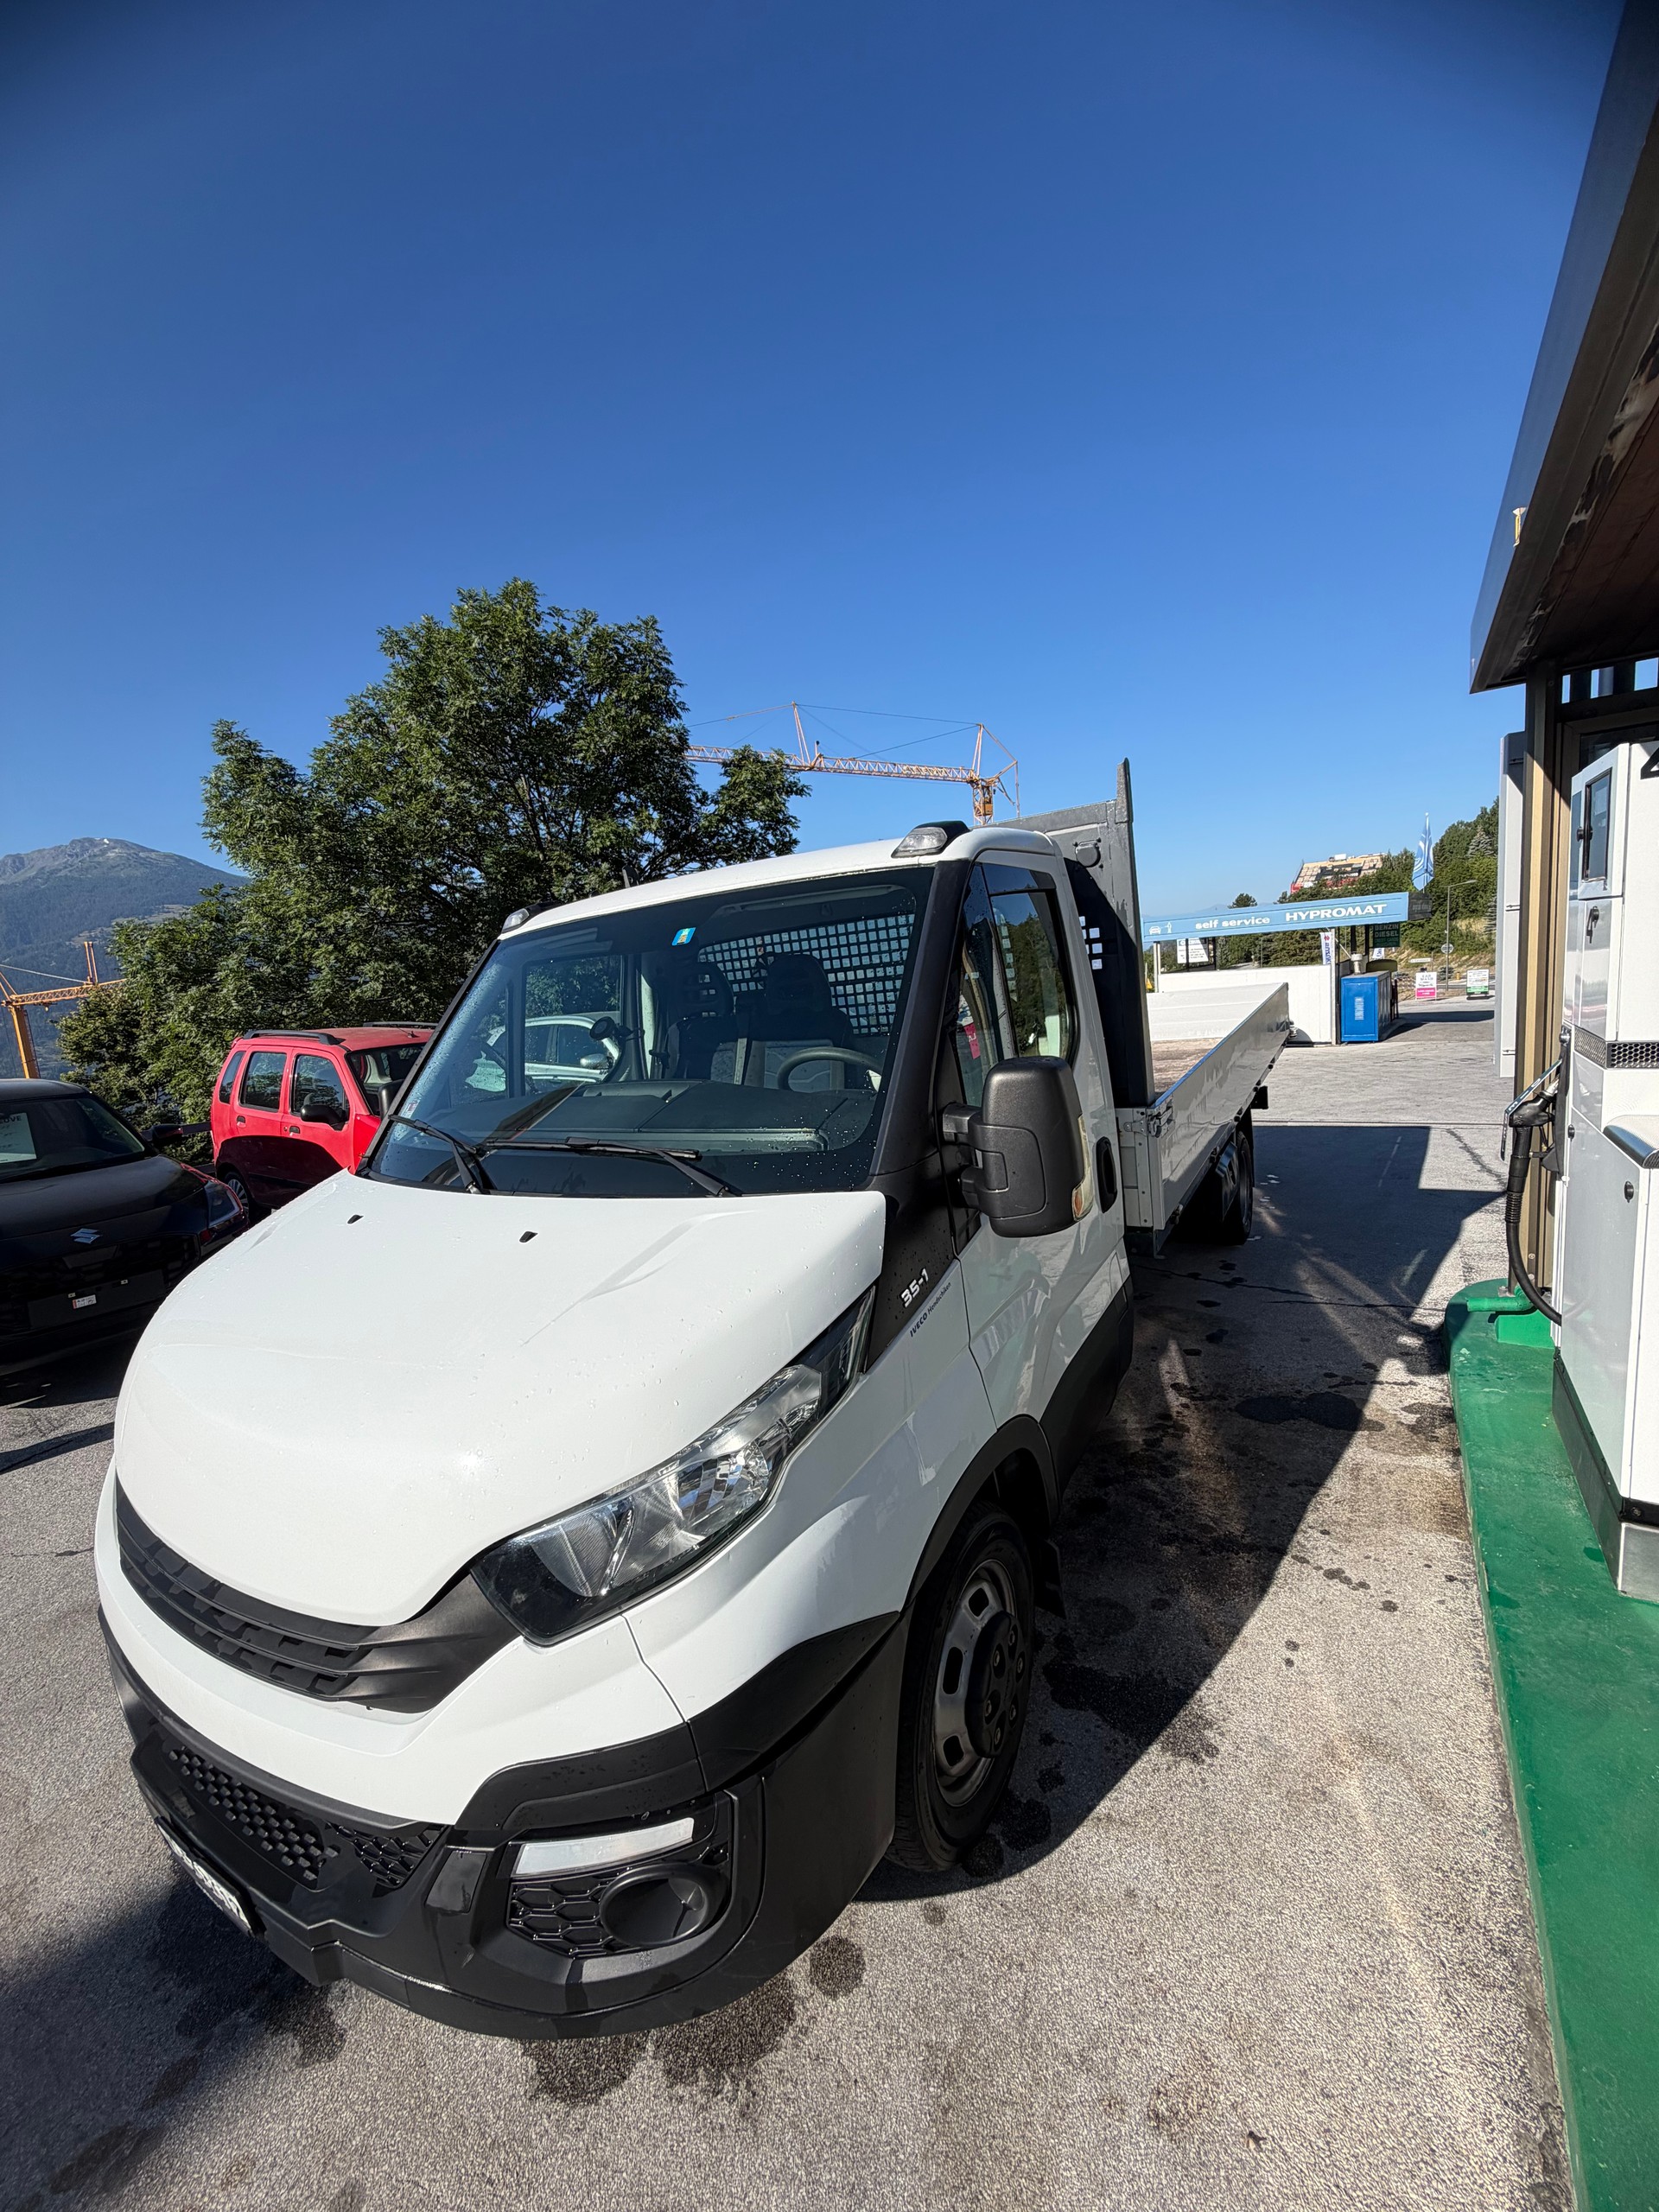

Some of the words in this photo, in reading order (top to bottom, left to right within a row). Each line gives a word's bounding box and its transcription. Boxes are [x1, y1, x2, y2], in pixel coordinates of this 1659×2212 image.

[1195, 919, 1218, 930] self
[1221, 916, 1270, 927] service
[1285, 904, 1387, 921] HYPROMAT
[901, 1268, 929, 1308] 35-1
[909, 1313, 928, 1338] IVECO
